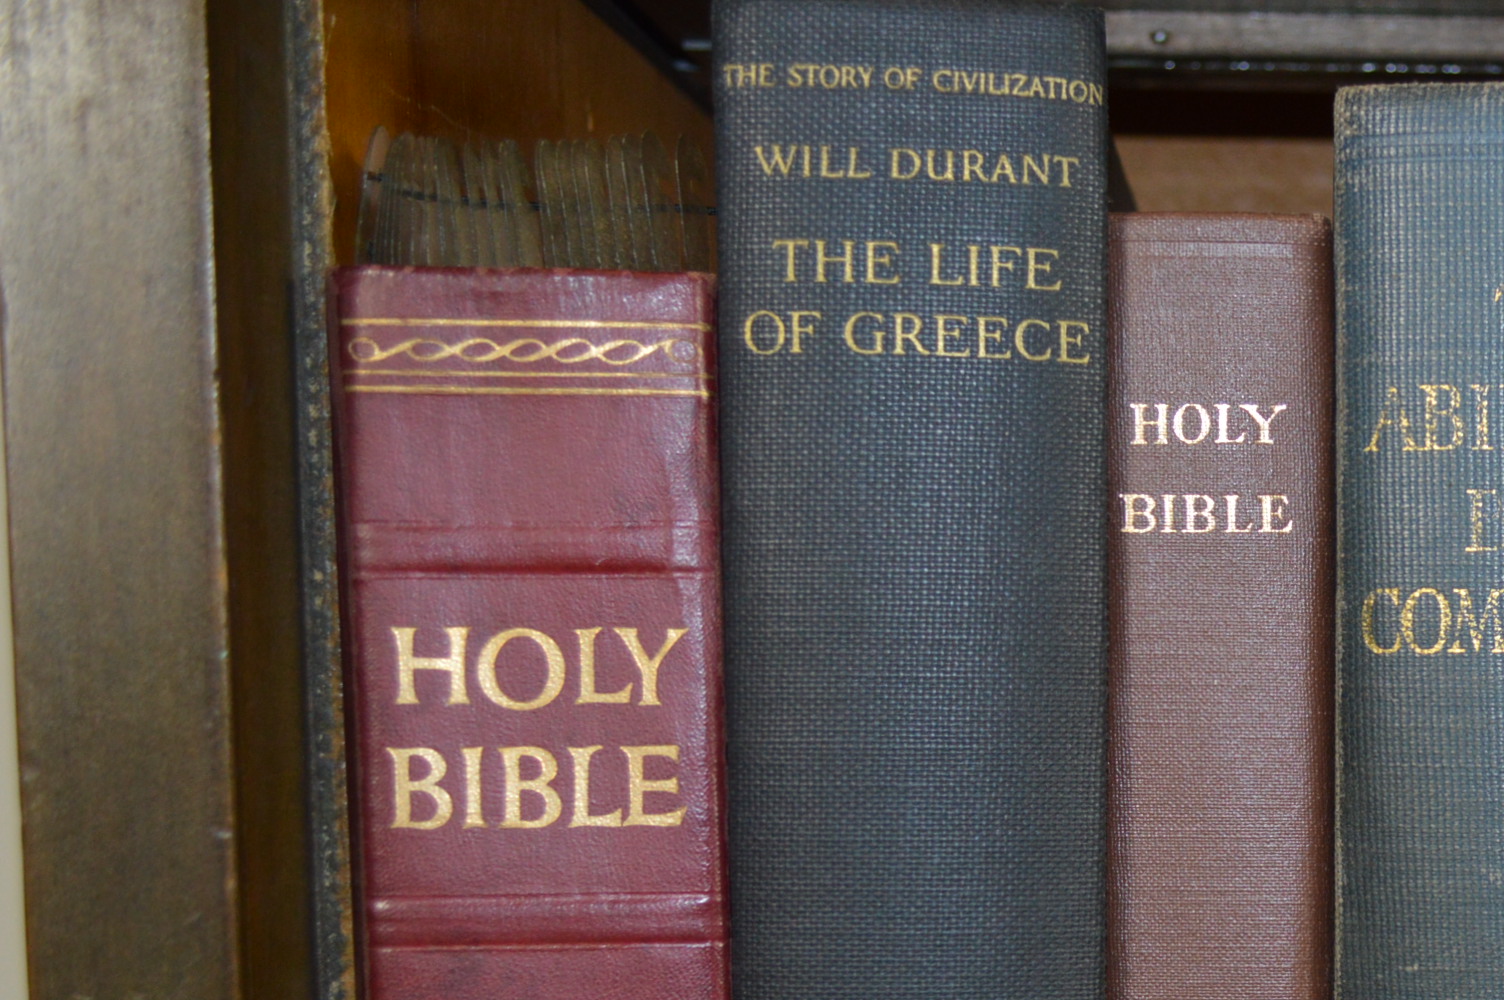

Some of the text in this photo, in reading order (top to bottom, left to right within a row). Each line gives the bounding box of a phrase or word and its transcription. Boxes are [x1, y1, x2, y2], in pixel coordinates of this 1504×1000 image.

[724, 63, 1103, 106] THE STORY OF CIVILIZATION
[754, 144, 1079, 188] WILL DURANT
[772, 239, 1062, 291] THE LIFE
[743, 310, 1091, 364] OF GREECE
[1129, 403, 1287, 446] HOLY
[1119, 493, 1294, 534] BIBLE
[390, 625, 689, 712] HOLY
[385, 744, 688, 830] BIBLE
